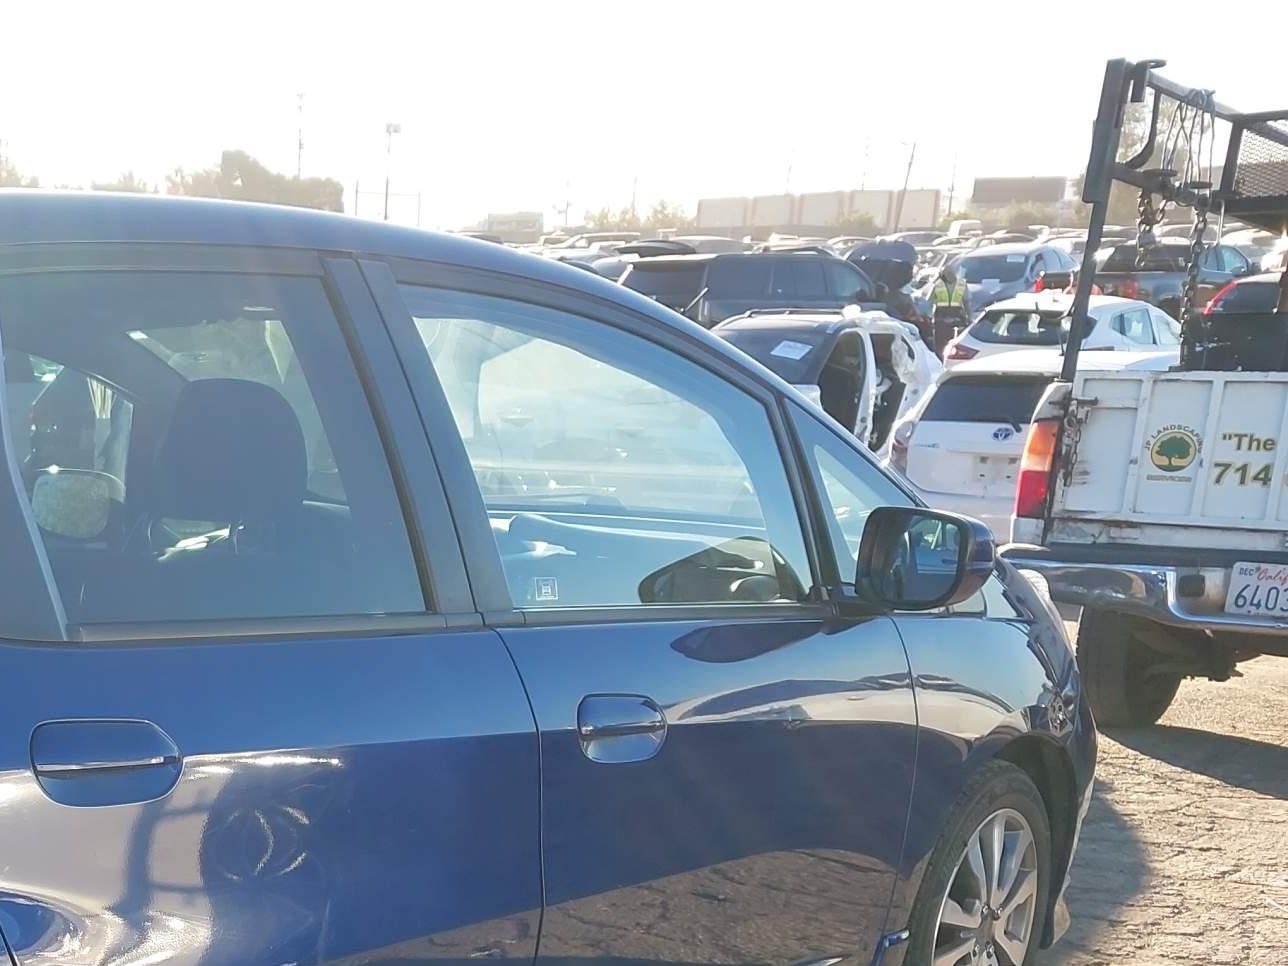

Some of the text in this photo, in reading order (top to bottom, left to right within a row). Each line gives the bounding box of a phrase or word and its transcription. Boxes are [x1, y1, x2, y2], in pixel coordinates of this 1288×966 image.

[1222, 432, 1275, 451] "The
[1214, 462, 1272, 486] 714
[1239, 567, 1255, 576] DEC
